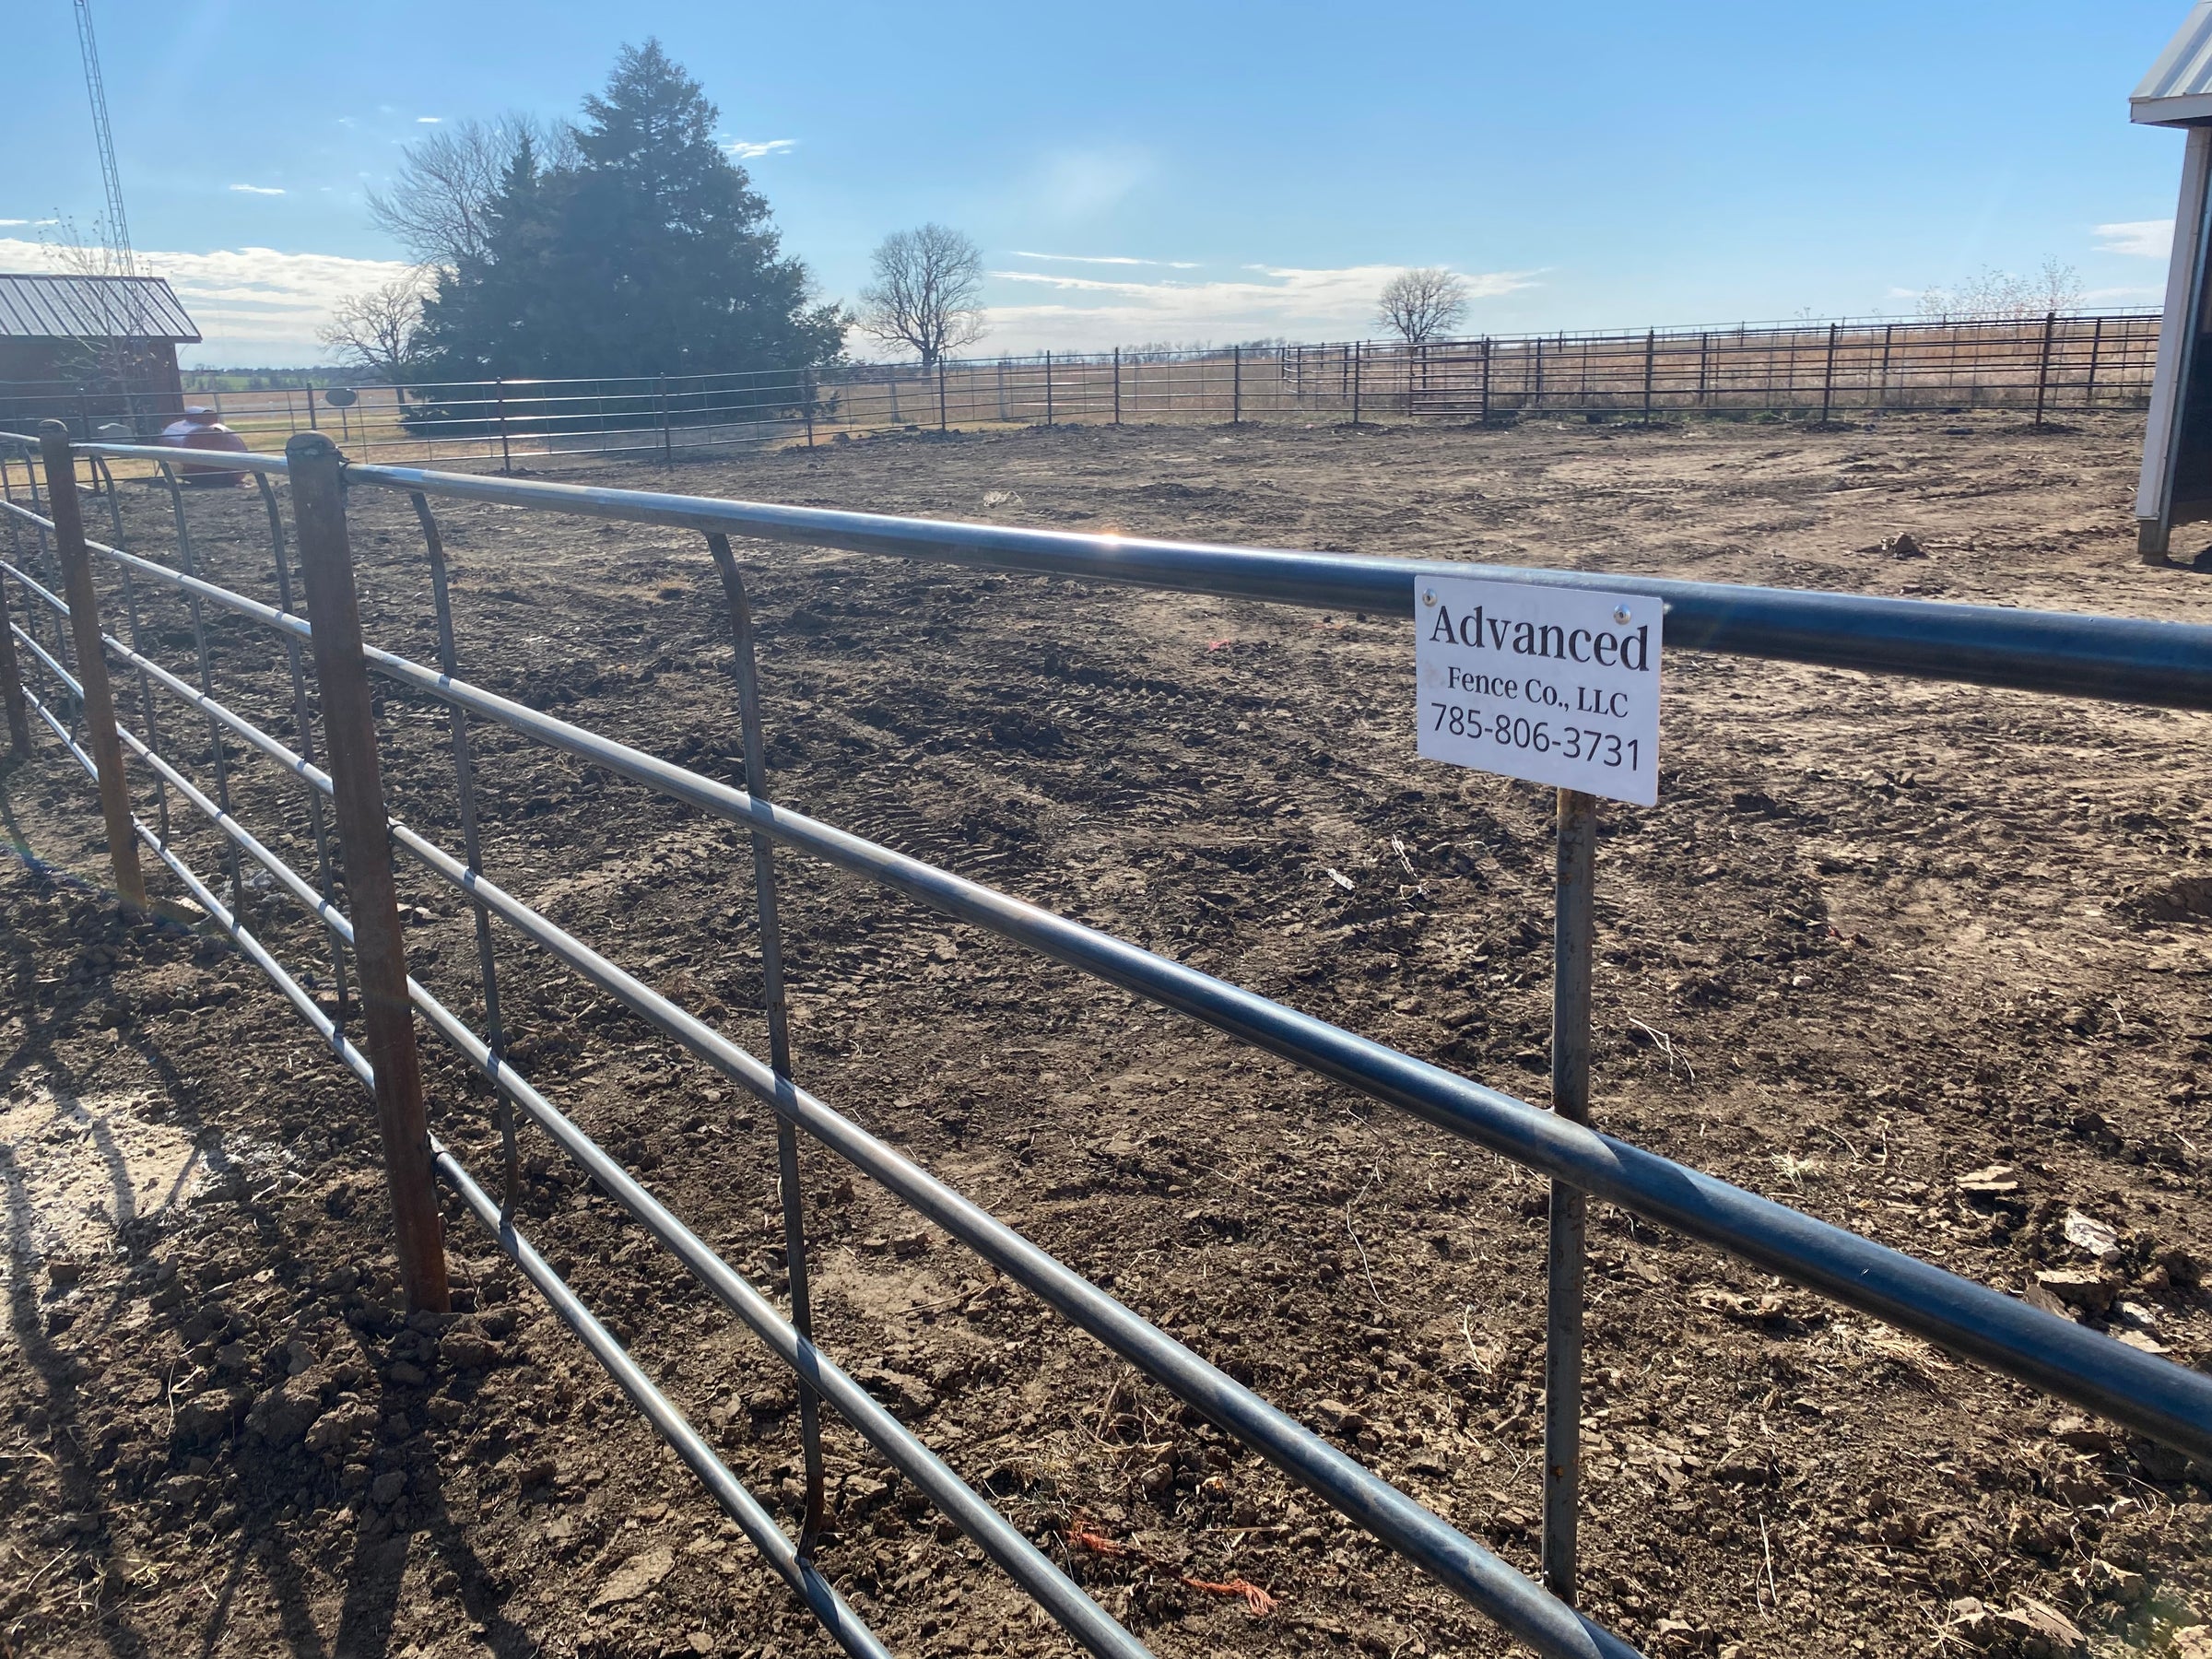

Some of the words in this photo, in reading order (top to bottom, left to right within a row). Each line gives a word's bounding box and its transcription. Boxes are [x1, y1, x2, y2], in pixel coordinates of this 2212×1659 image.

[1429, 605, 1650, 672] Advanced
[1447, 666, 1518, 699] Fence
[1524, 678, 1570, 712] Co.,
[1577, 687, 1629, 718] LLC
[1430, 702, 1639, 771] 785-806-3731
